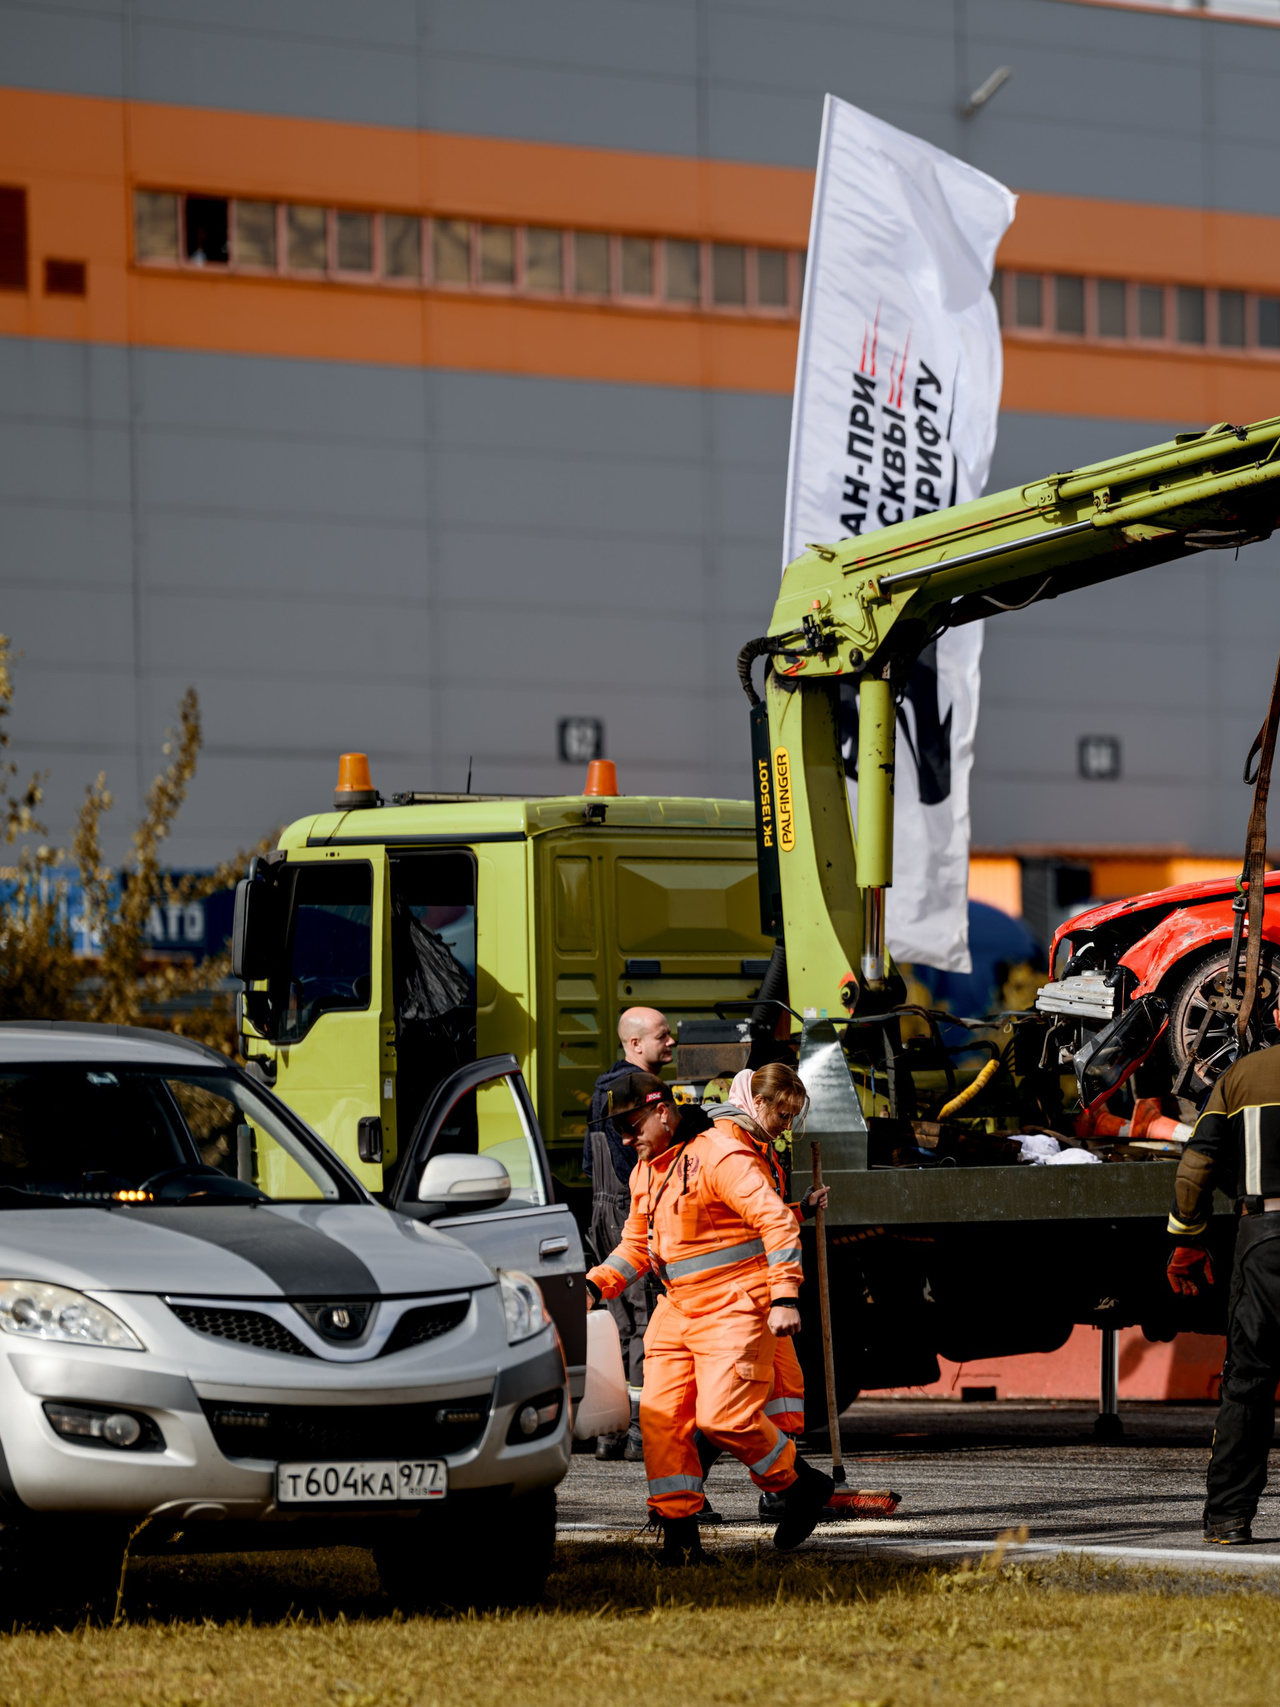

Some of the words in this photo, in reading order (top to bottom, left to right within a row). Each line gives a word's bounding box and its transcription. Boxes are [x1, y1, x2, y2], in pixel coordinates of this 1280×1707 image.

[839, 371, 877, 541] АН-ПРИ
[876, 404, 907, 528] СКВЫ
[758, 759, 771, 822] 13500T
[776, 753, 793, 845] PALFINGER
[762, 823, 774, 847] PK
[287, 1466, 395, 1497] Т604КА
[399, 1463, 439, 1487] 977
[408, 1487, 428, 1496] RUS
